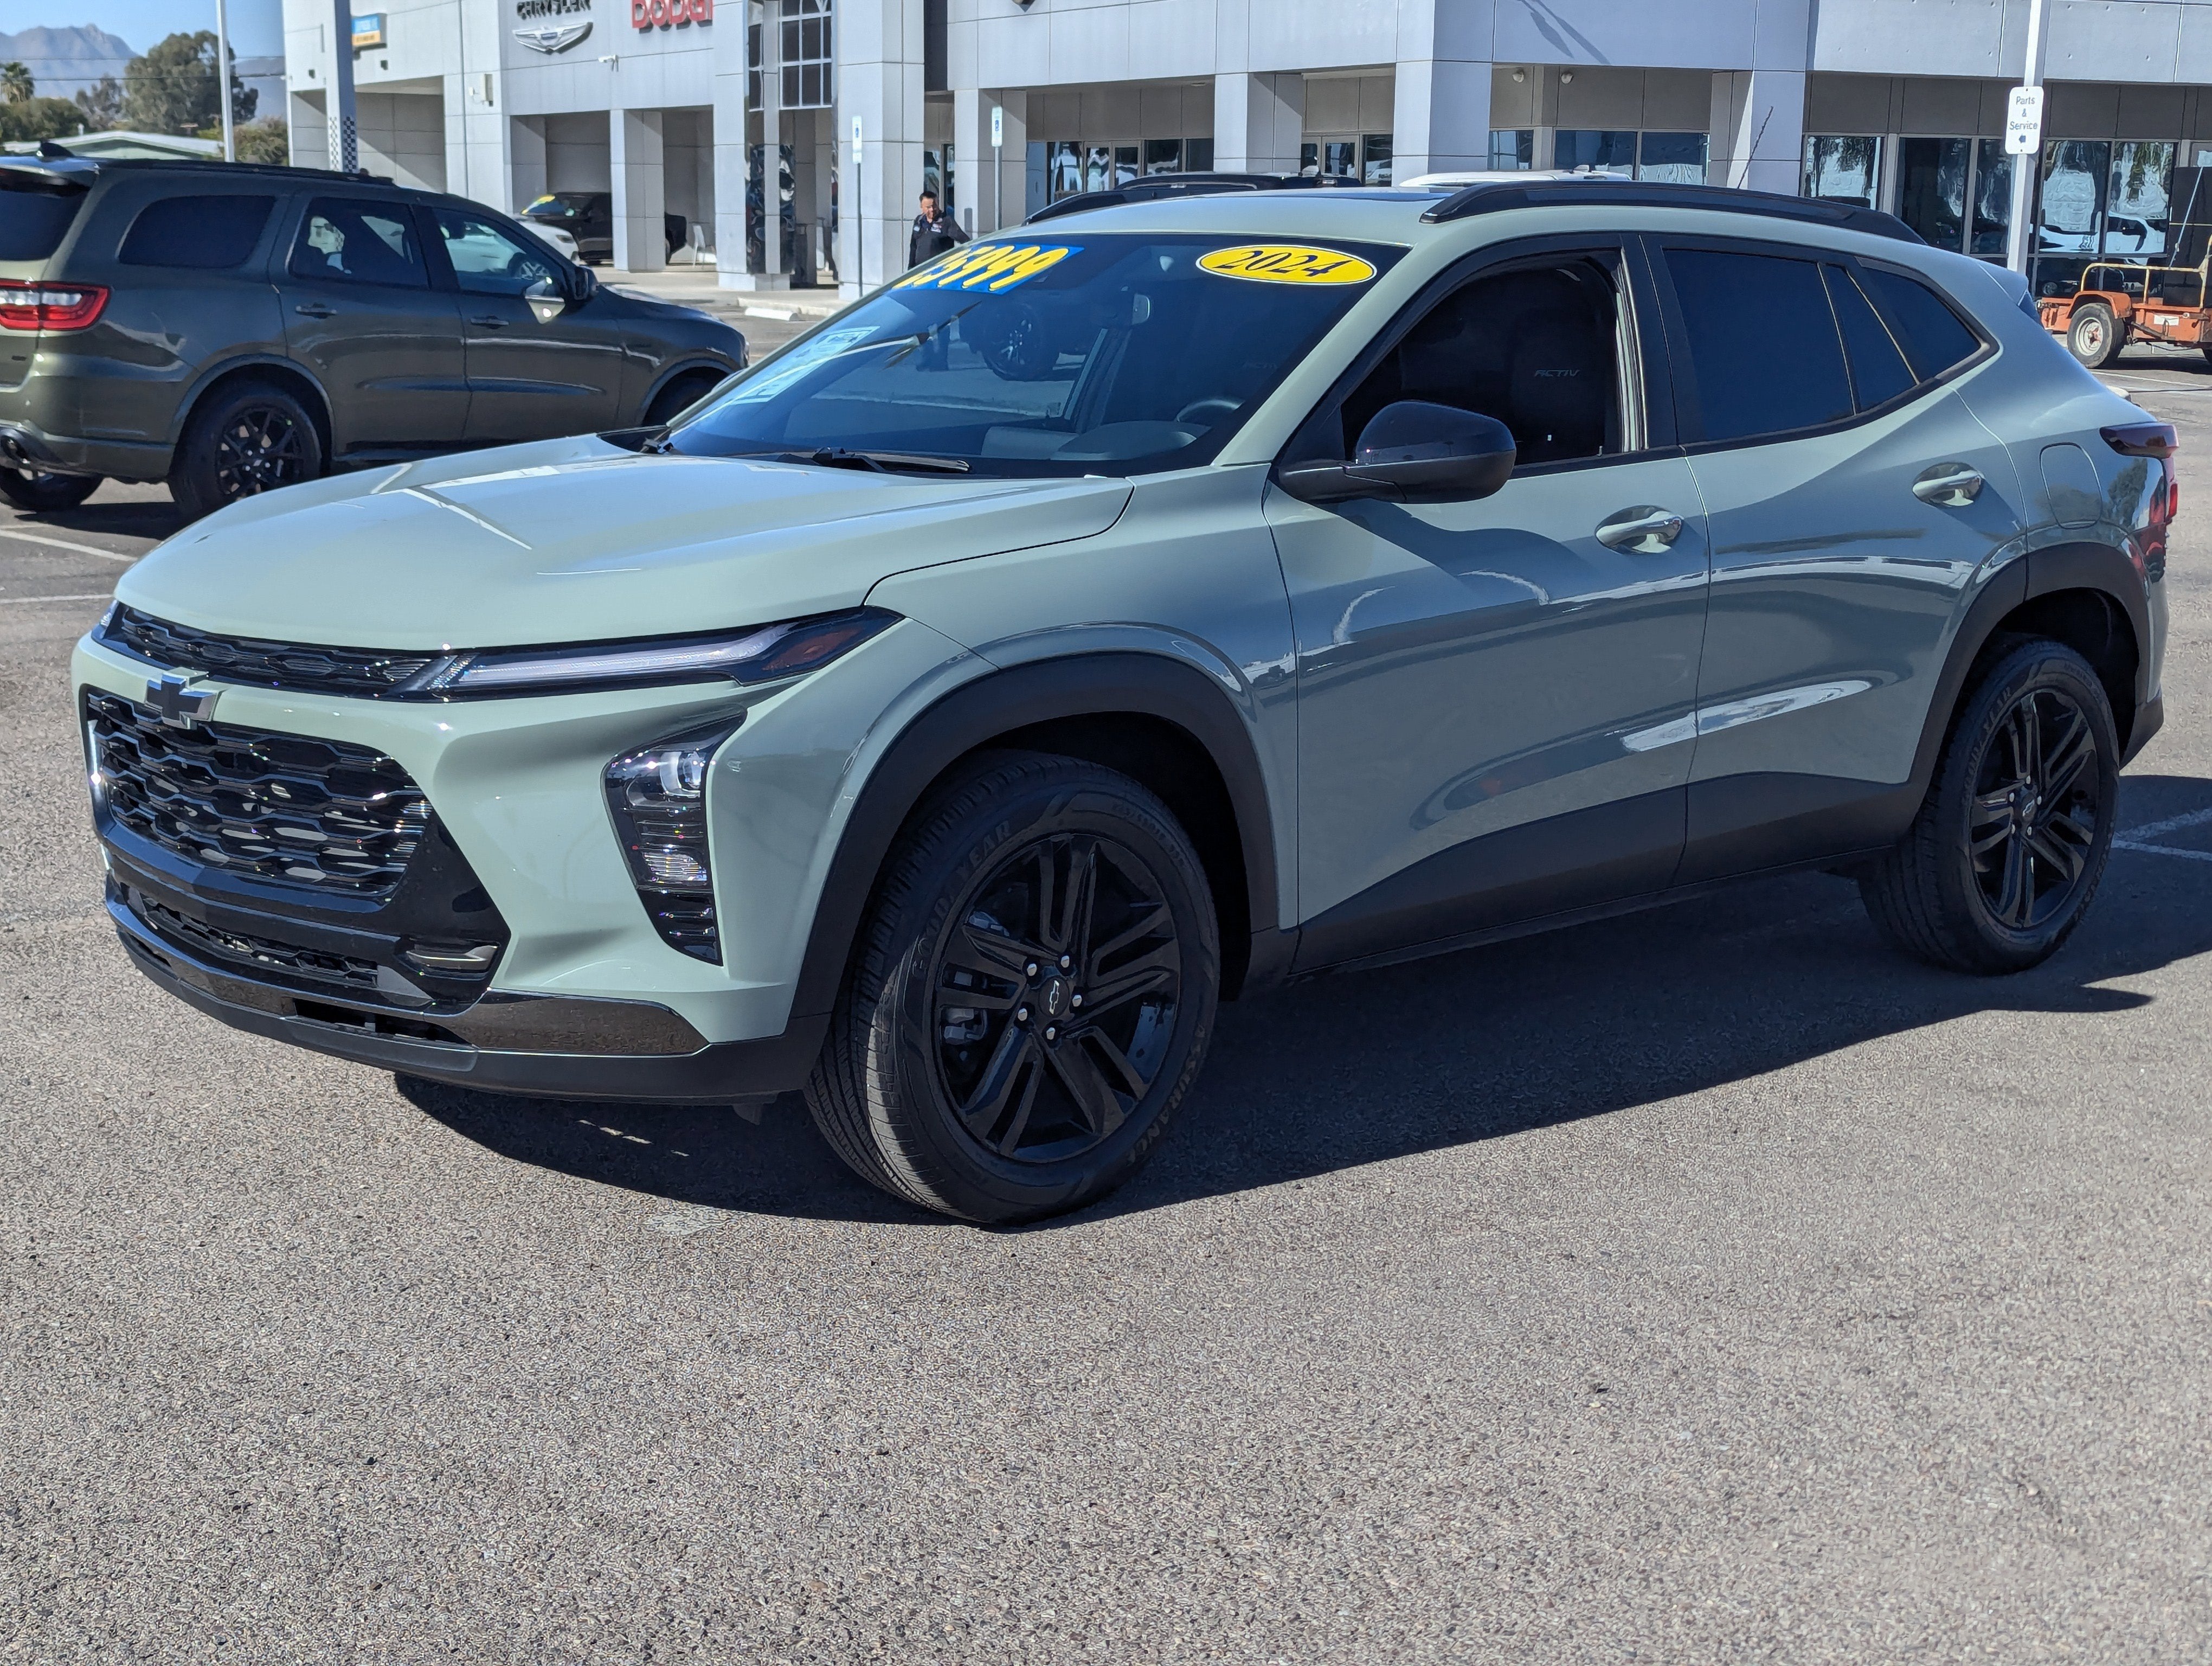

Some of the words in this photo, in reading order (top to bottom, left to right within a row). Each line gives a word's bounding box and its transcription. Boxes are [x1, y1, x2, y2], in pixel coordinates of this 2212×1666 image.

[632, 0, 713, 28] DODG
[2016, 96, 2035, 105] Parts
[2022, 108, 2027, 117] &
[2009, 121, 2037, 130] Service
[1213, 250, 1353, 277] 2024
